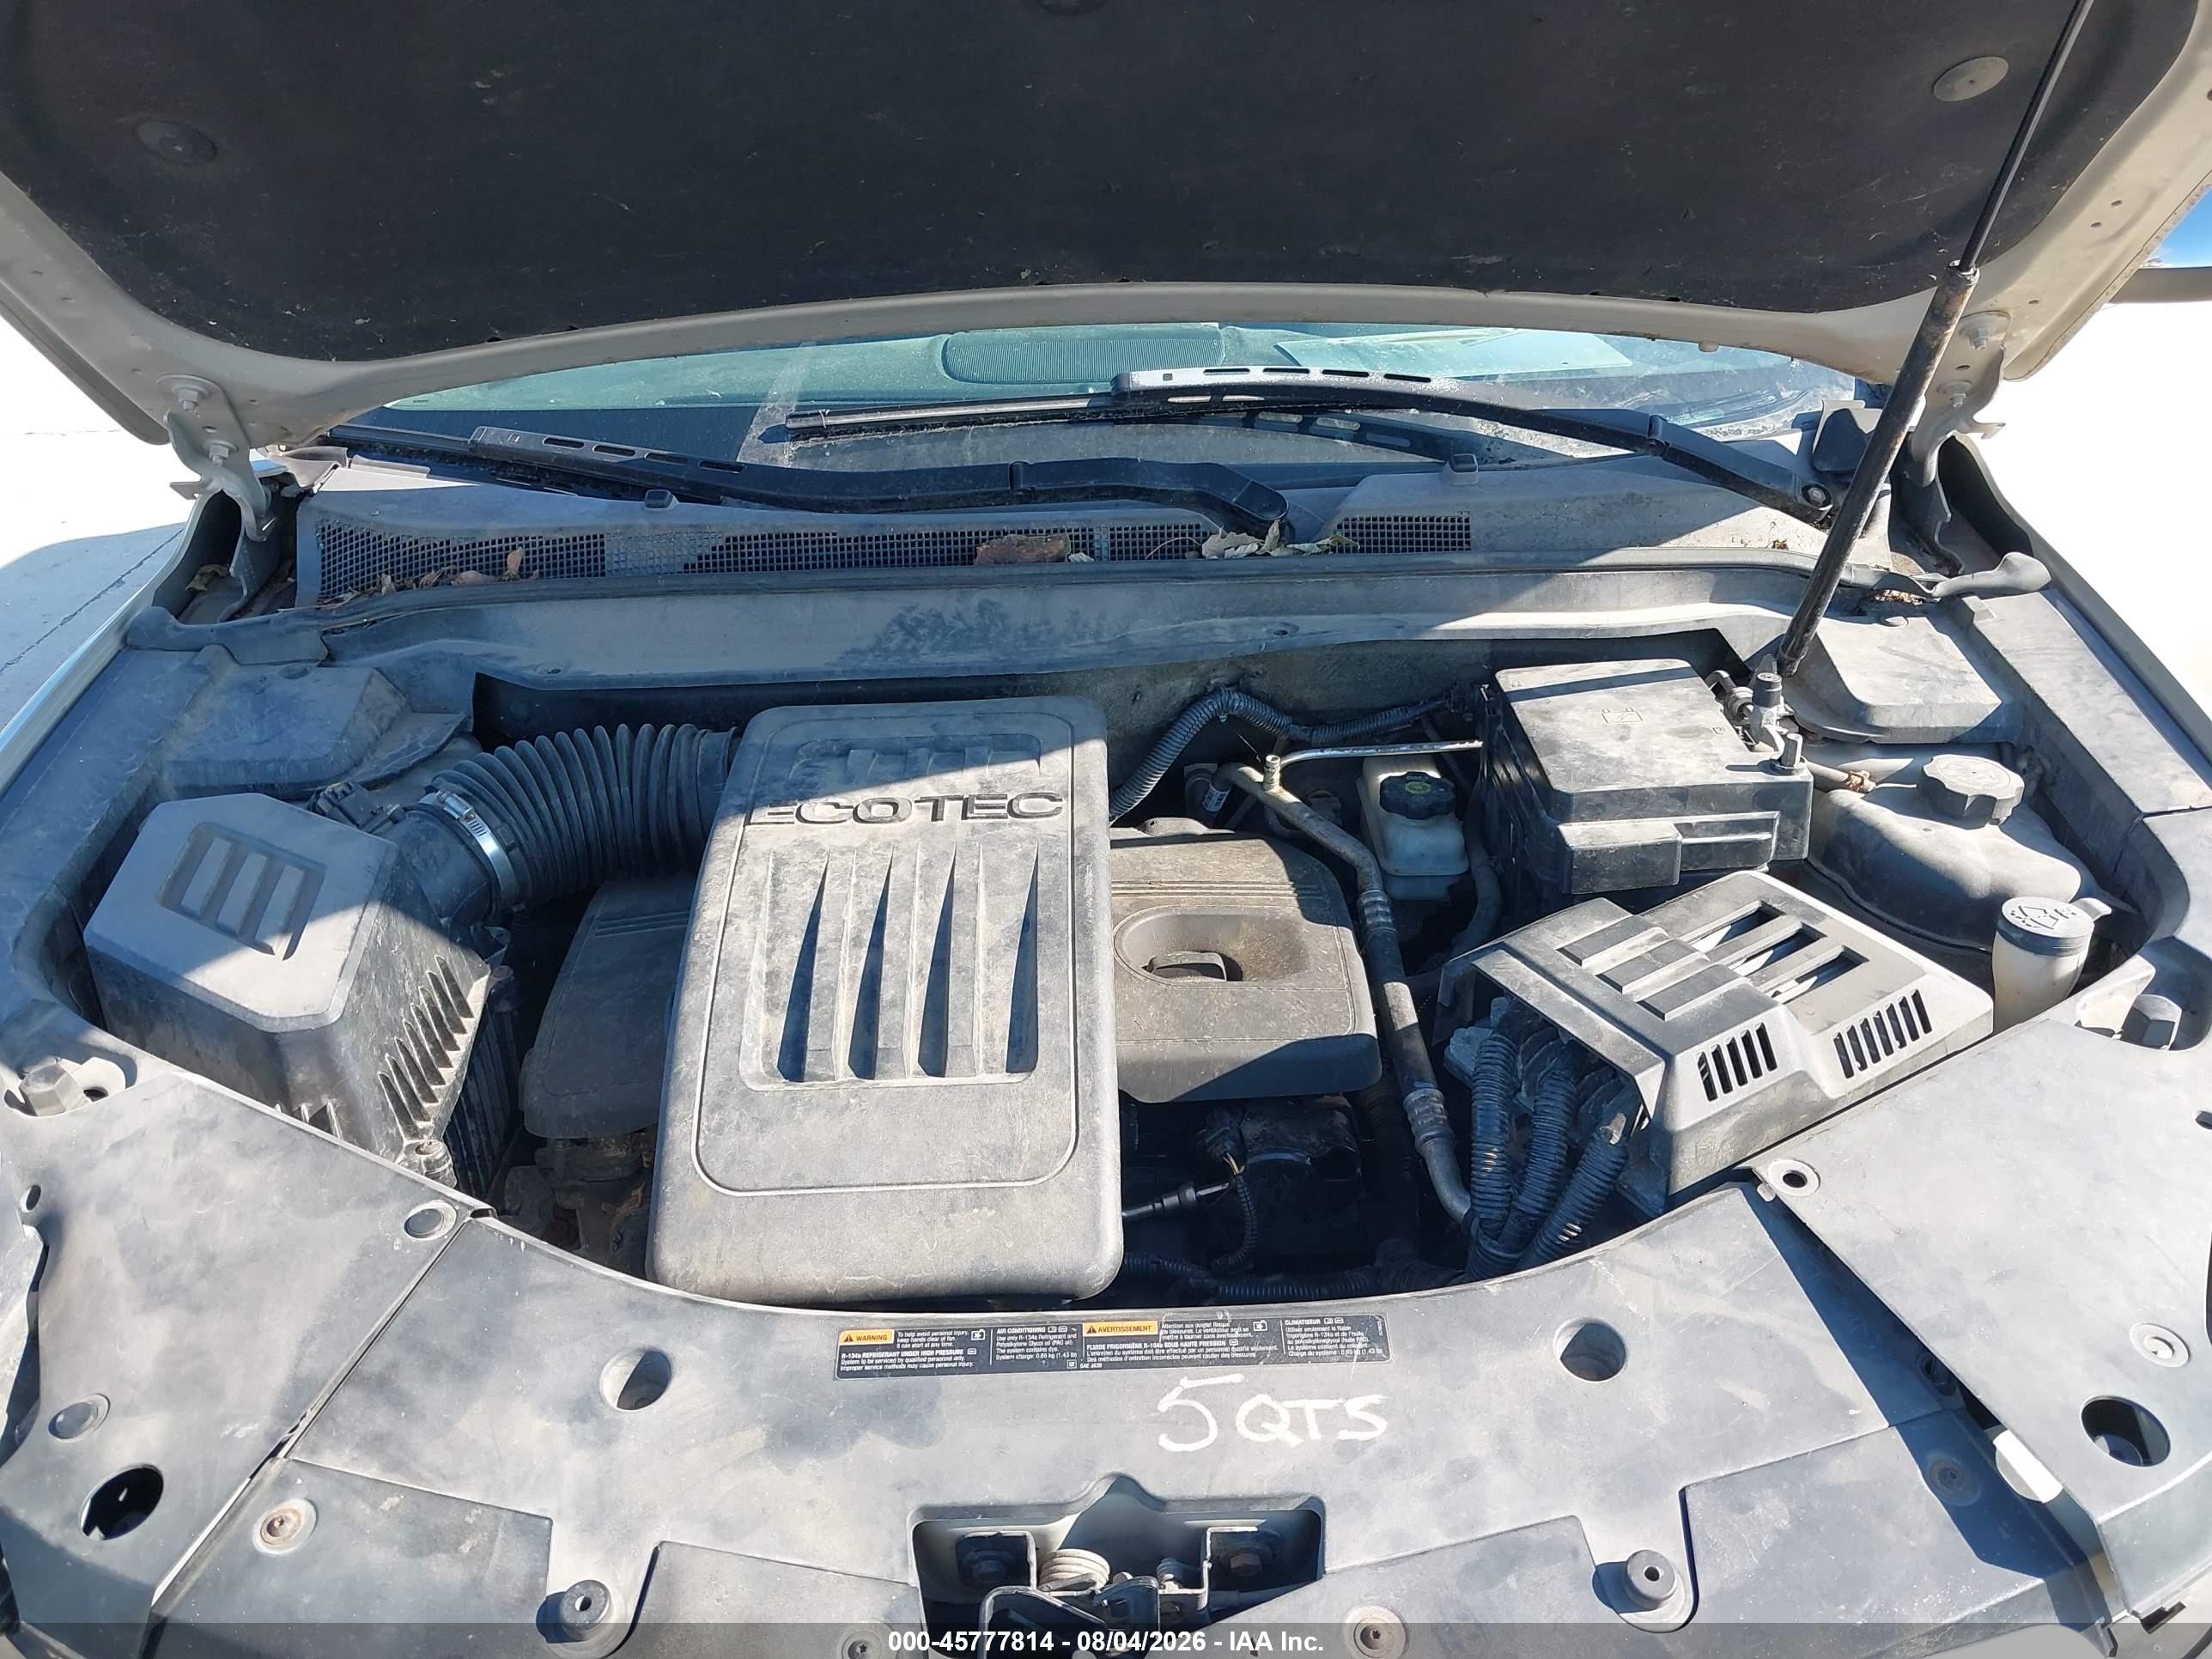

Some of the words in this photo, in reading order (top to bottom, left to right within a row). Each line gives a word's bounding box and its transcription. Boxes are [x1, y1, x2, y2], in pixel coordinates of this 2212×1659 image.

[744, 791, 1064, 826] ECOTEC
[1158, 1373, 1245, 1453] 5
[1235, 1394, 1389, 1447] QTS
